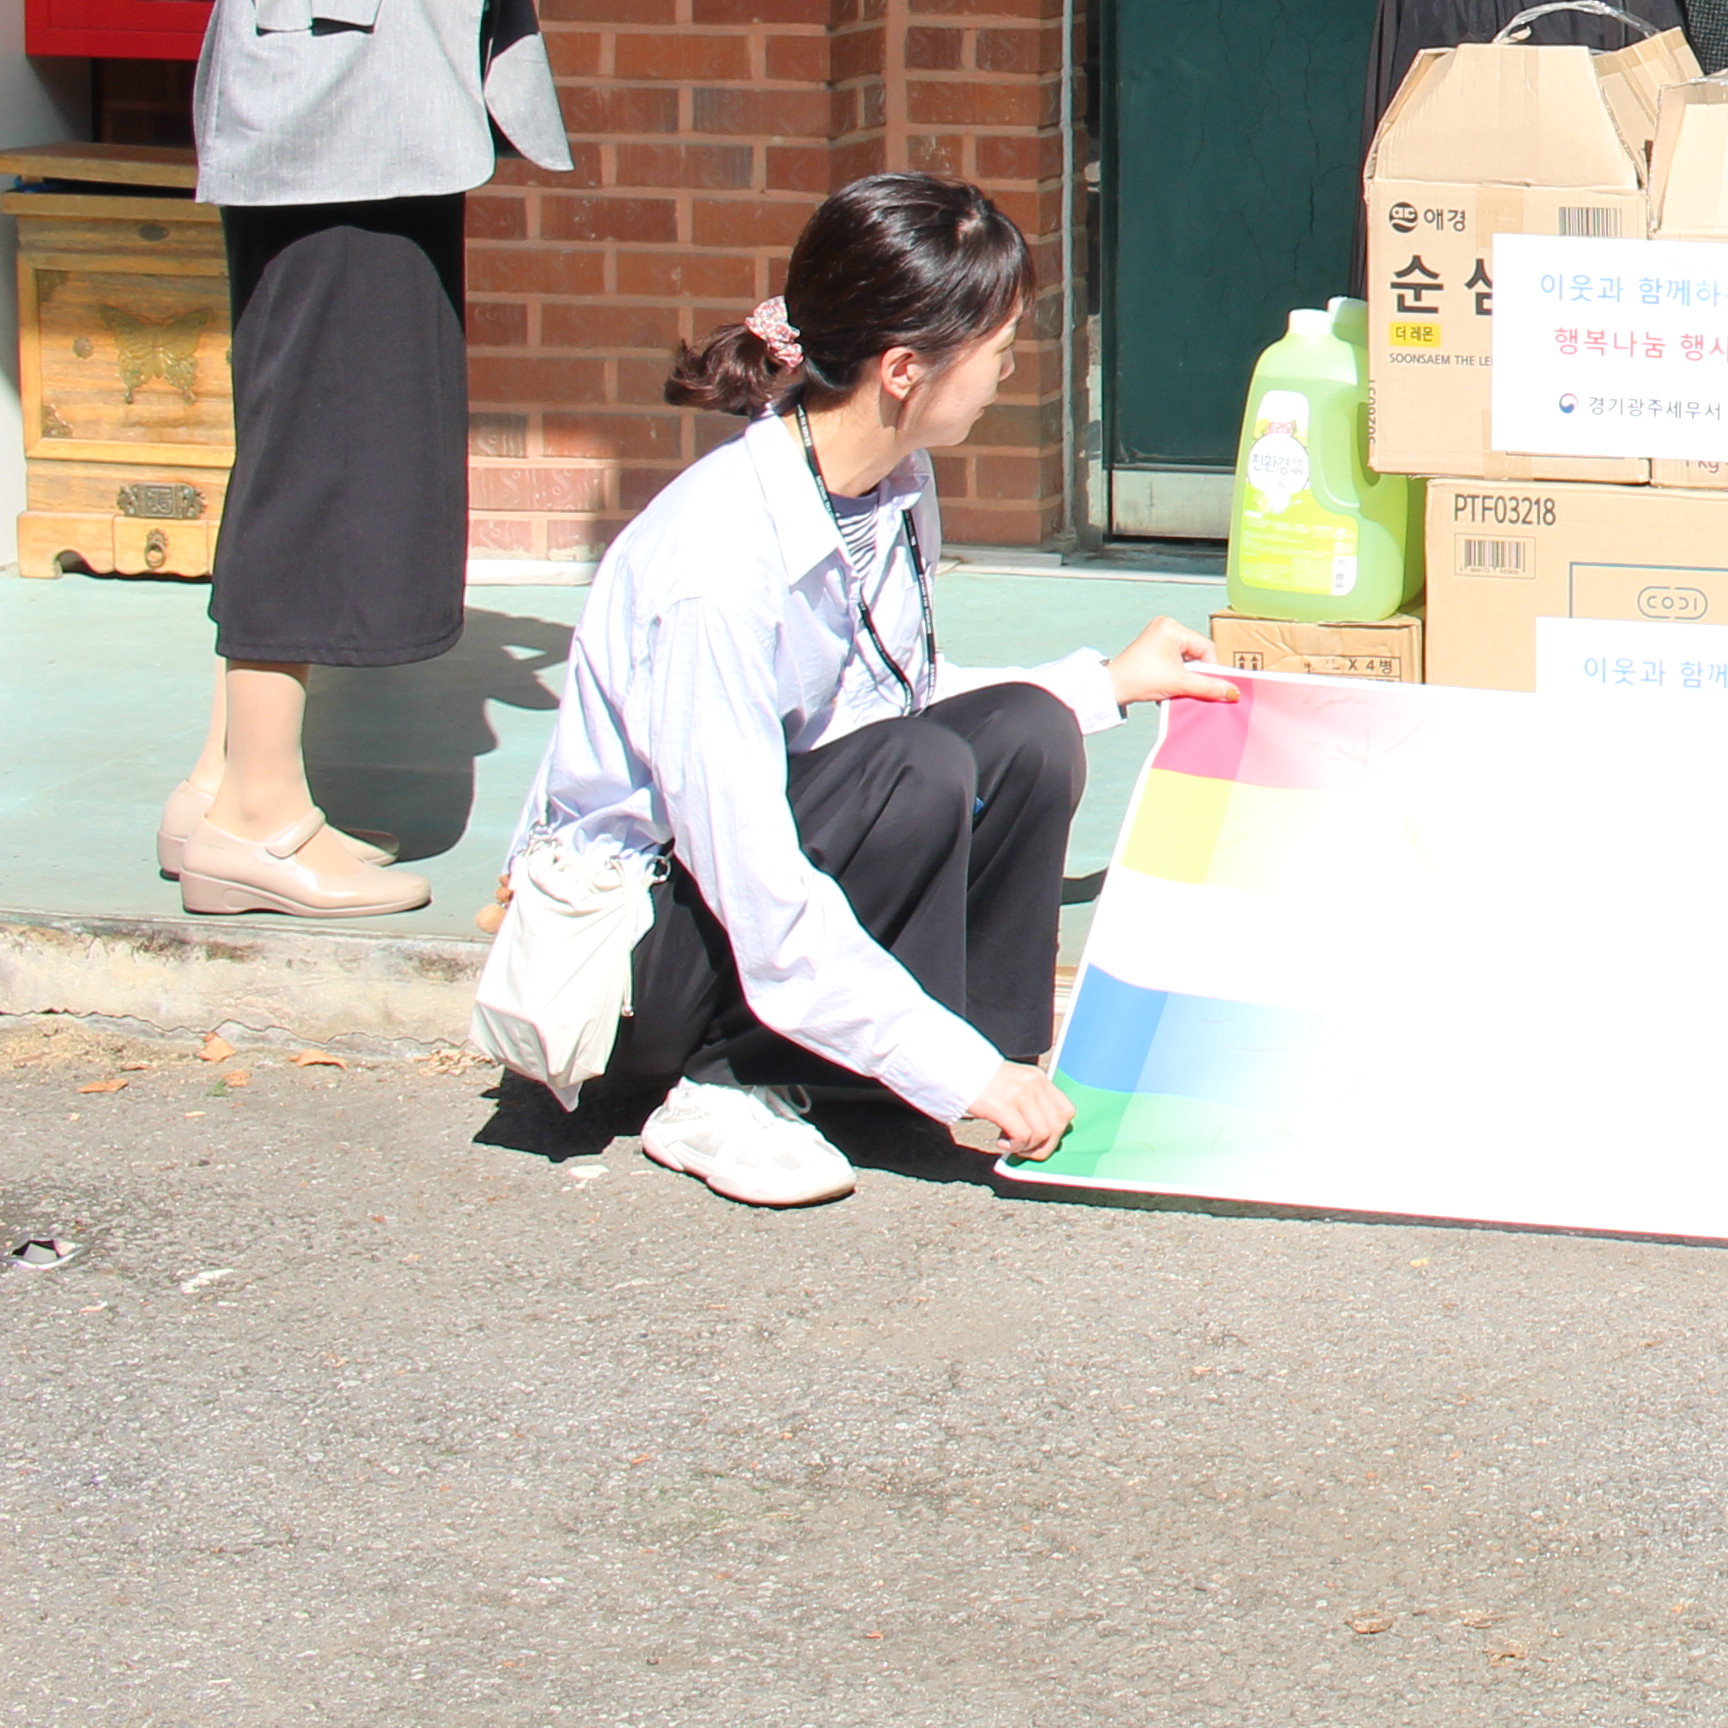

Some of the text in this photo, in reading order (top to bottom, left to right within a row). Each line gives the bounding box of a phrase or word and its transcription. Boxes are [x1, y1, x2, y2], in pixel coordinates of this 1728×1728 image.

[1422, 208, 1467, 232] 애경
[1540, 272, 1624, 303] 이웃과
[1395, 325, 1434, 343] 더 레몬
[1553, 326, 1668, 361] 행복나눔
[1388, 352, 1493, 367] SOONSAEM THE LE
[1587, 395, 1723, 422] 경기광주세무서
[1266, 421, 1296, 434] 트리오
[1251, 453, 1290, 476] 친환경
[1453, 493, 1557, 526] PTF03218
[1583, 656, 1666, 687] 이웃과
